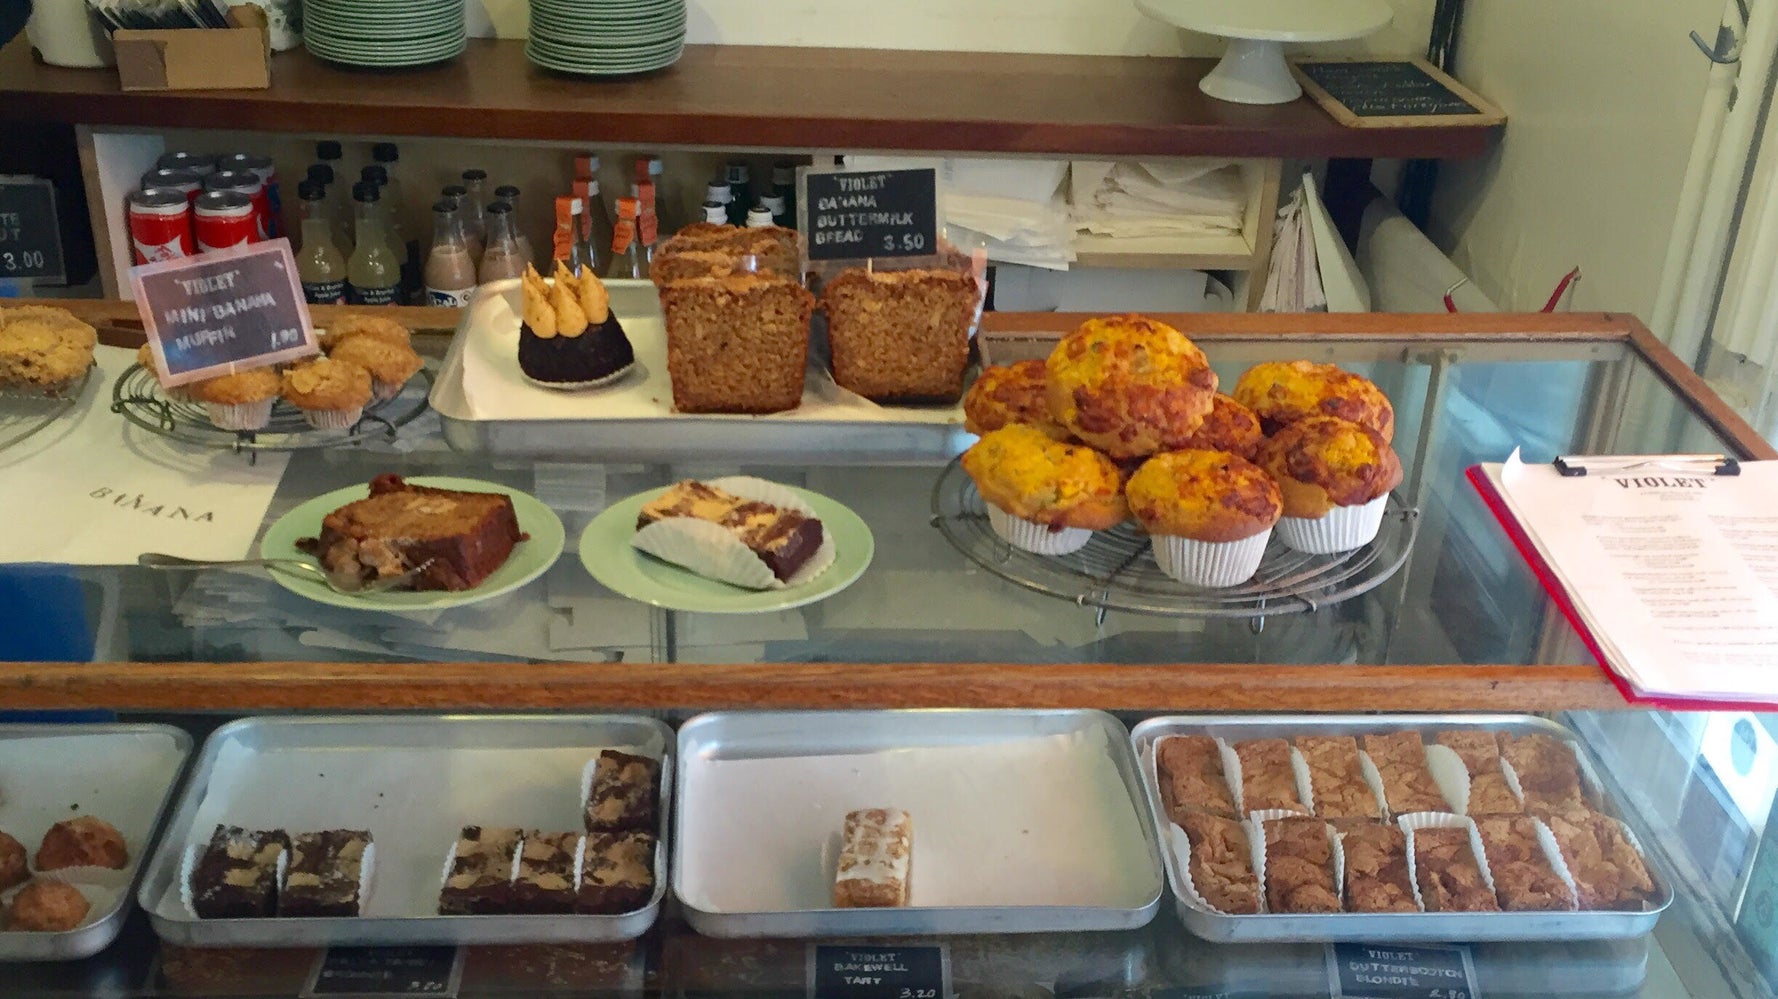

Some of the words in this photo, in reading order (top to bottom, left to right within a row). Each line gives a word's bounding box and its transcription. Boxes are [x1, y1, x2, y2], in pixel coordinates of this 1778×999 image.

[817, 212, 914, 228] BUTTERMILK
[815, 229, 864, 245] BREAD
[883, 233, 925, 251] 3.50
[3, 250, 44, 270] 3.00
[164, 306, 207, 324] MINI
[212, 292, 277, 320] BANANA
[175, 326, 236, 351] MUFFIN
[834, 963, 908, 972] BAKEWELL
[844, 977, 882, 985] TART
[1356, 974, 1420, 987] BLONDIE
[900, 987, 936, 999] 3.20
